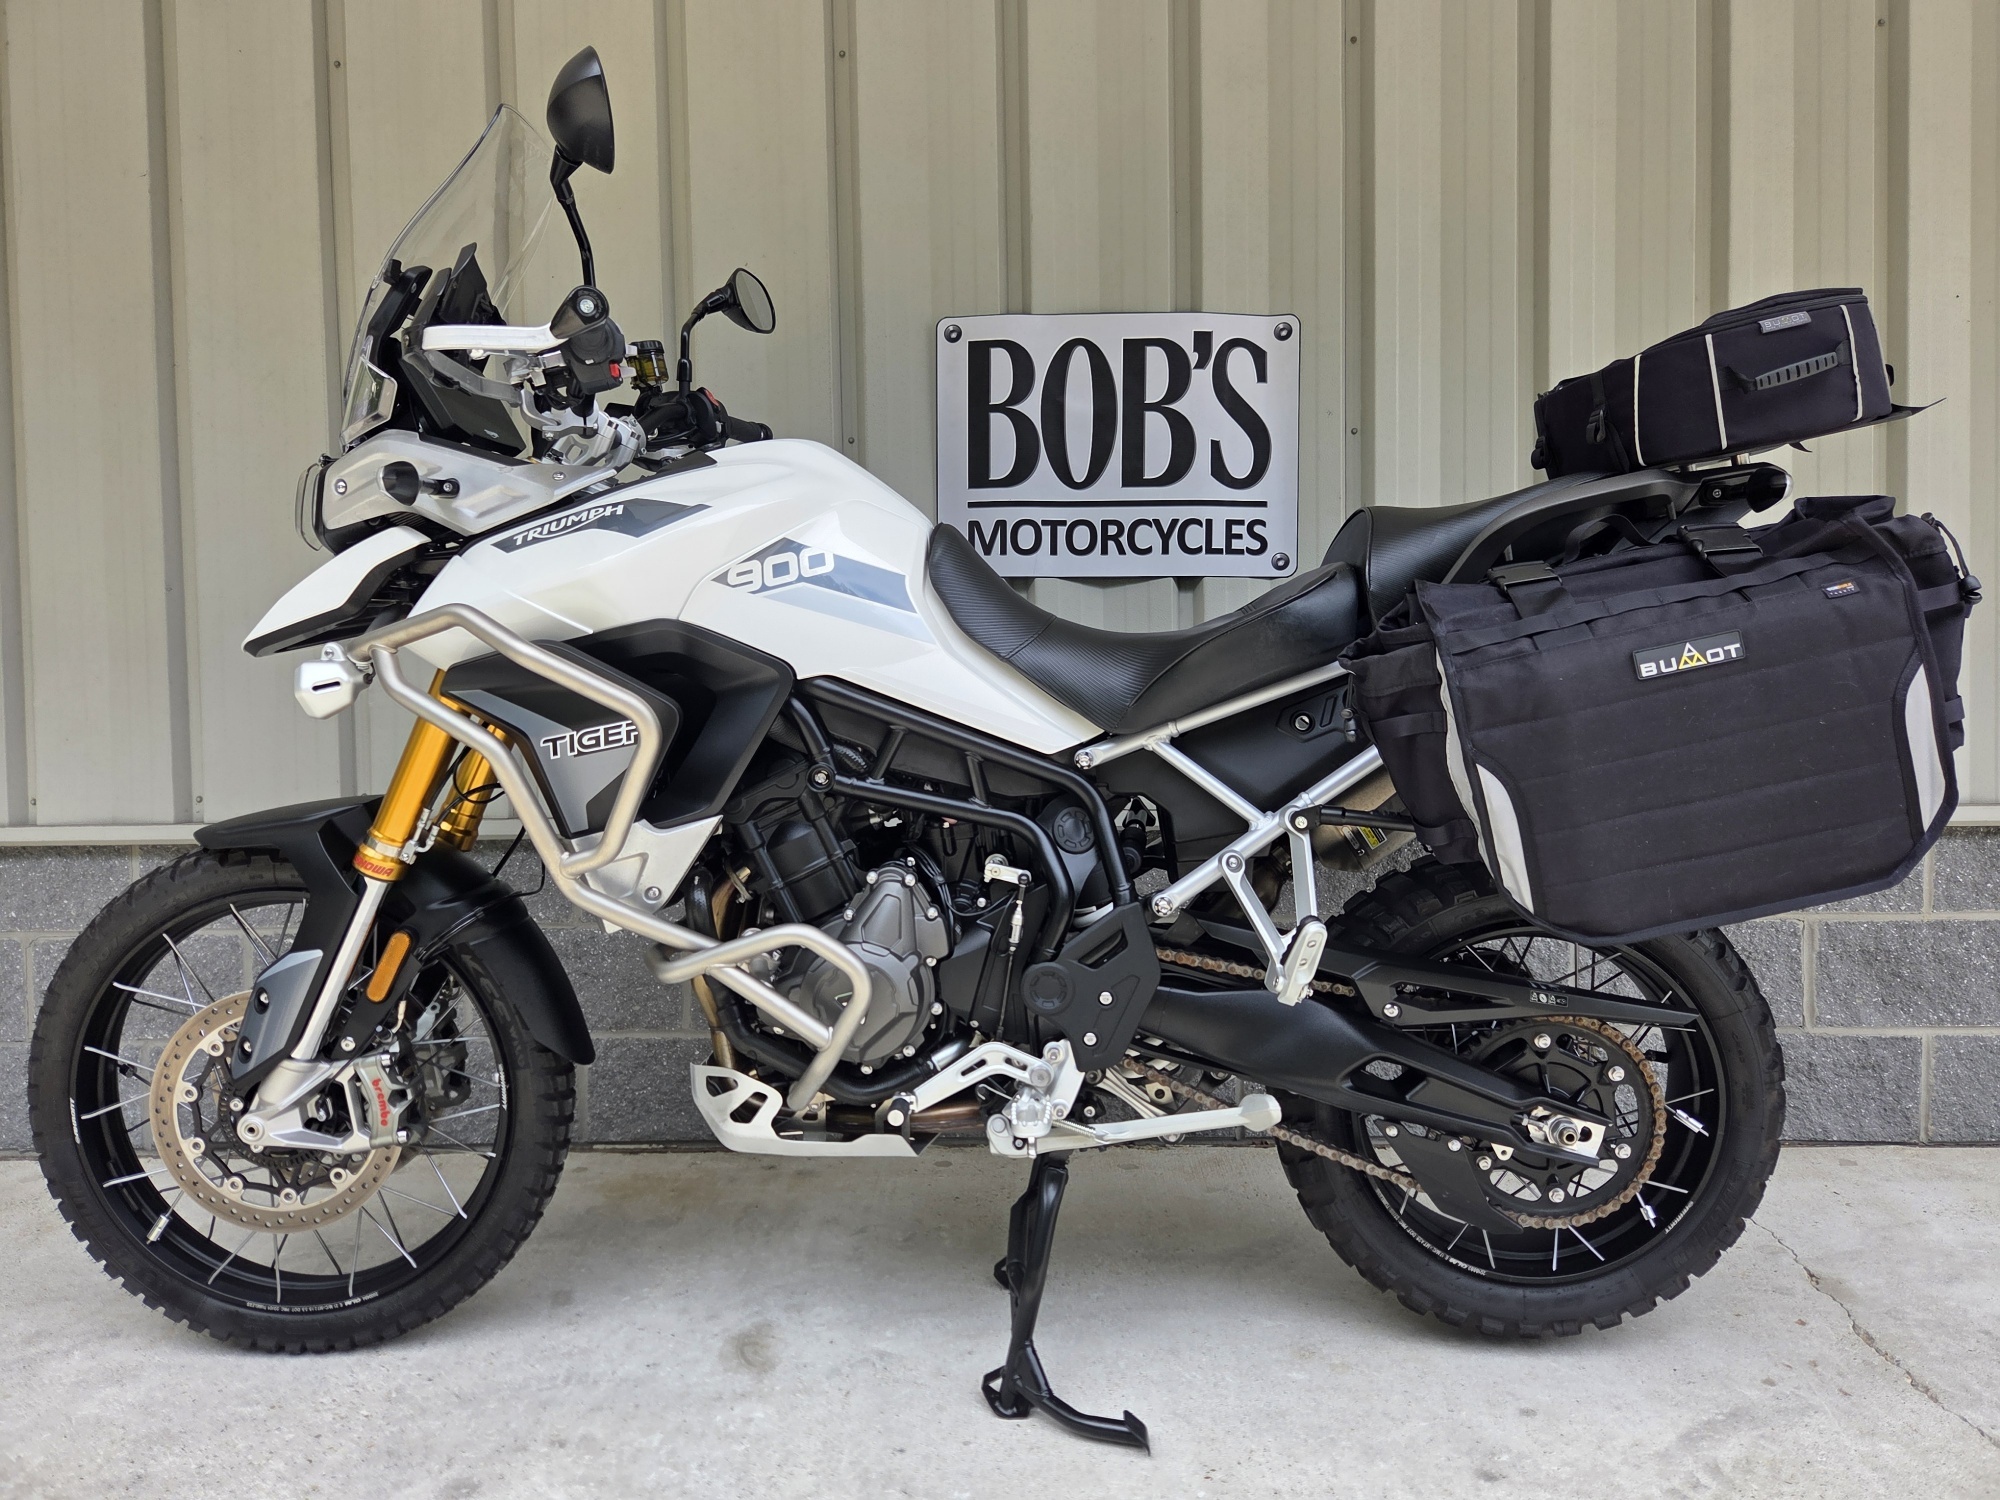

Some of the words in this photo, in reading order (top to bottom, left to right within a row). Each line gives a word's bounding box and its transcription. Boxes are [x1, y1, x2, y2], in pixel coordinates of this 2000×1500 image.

[967, 330, 1272, 491] BOB'S
[512, 503, 625, 547] TRIUMPH
[967, 517, 1269, 557] MOTORCYCLES
[726, 549, 836, 592] 900
[371, 1078, 391, 1127] brembo
